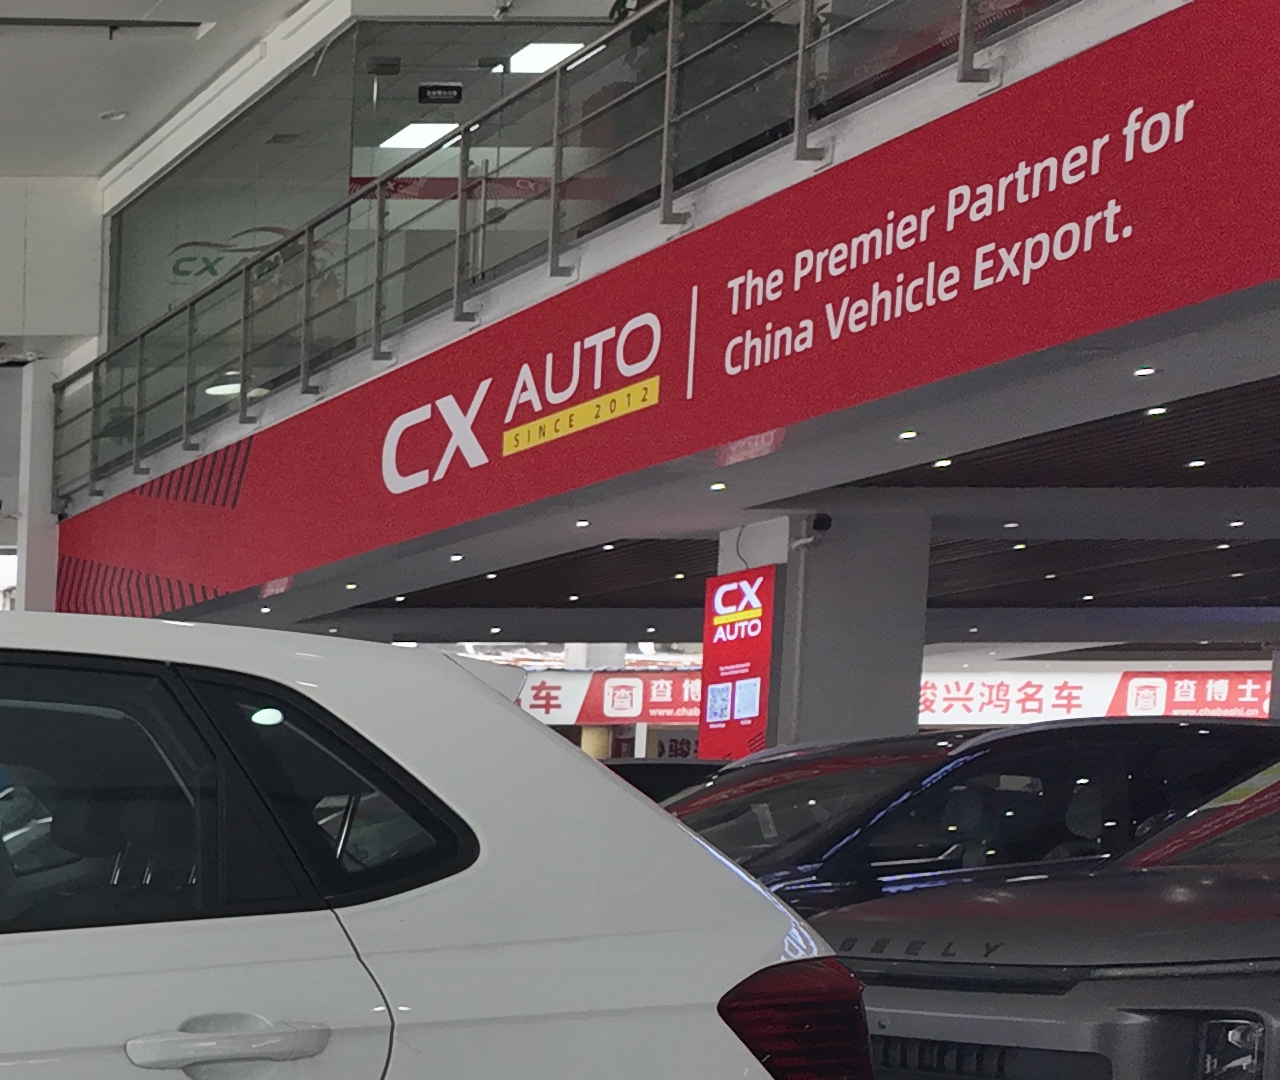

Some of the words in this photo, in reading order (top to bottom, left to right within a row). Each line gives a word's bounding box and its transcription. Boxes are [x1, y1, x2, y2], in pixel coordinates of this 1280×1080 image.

[727, 268, 783, 315] The
[793, 205, 935, 292] Premier
[946, 133, 1111, 232] Partner
[1123, 100, 1194, 163] for
[172, 256, 225, 277] CX
[724, 318, 813, 375] China
[824, 261, 959, 340] Vehicle
[972, 199, 1133, 285] Export.
[381, 377, 493, 494] CX
[504, 312, 661, 424] AUTO
[513, 413, 574, 448] SINCE
[594, 386, 649, 420] 2012
[714, 577, 764, 615] CX
[713, 619, 762, 644] AUTO
[514, 681, 562, 714] 车
[1173, 679, 1261, 702] 查博士
